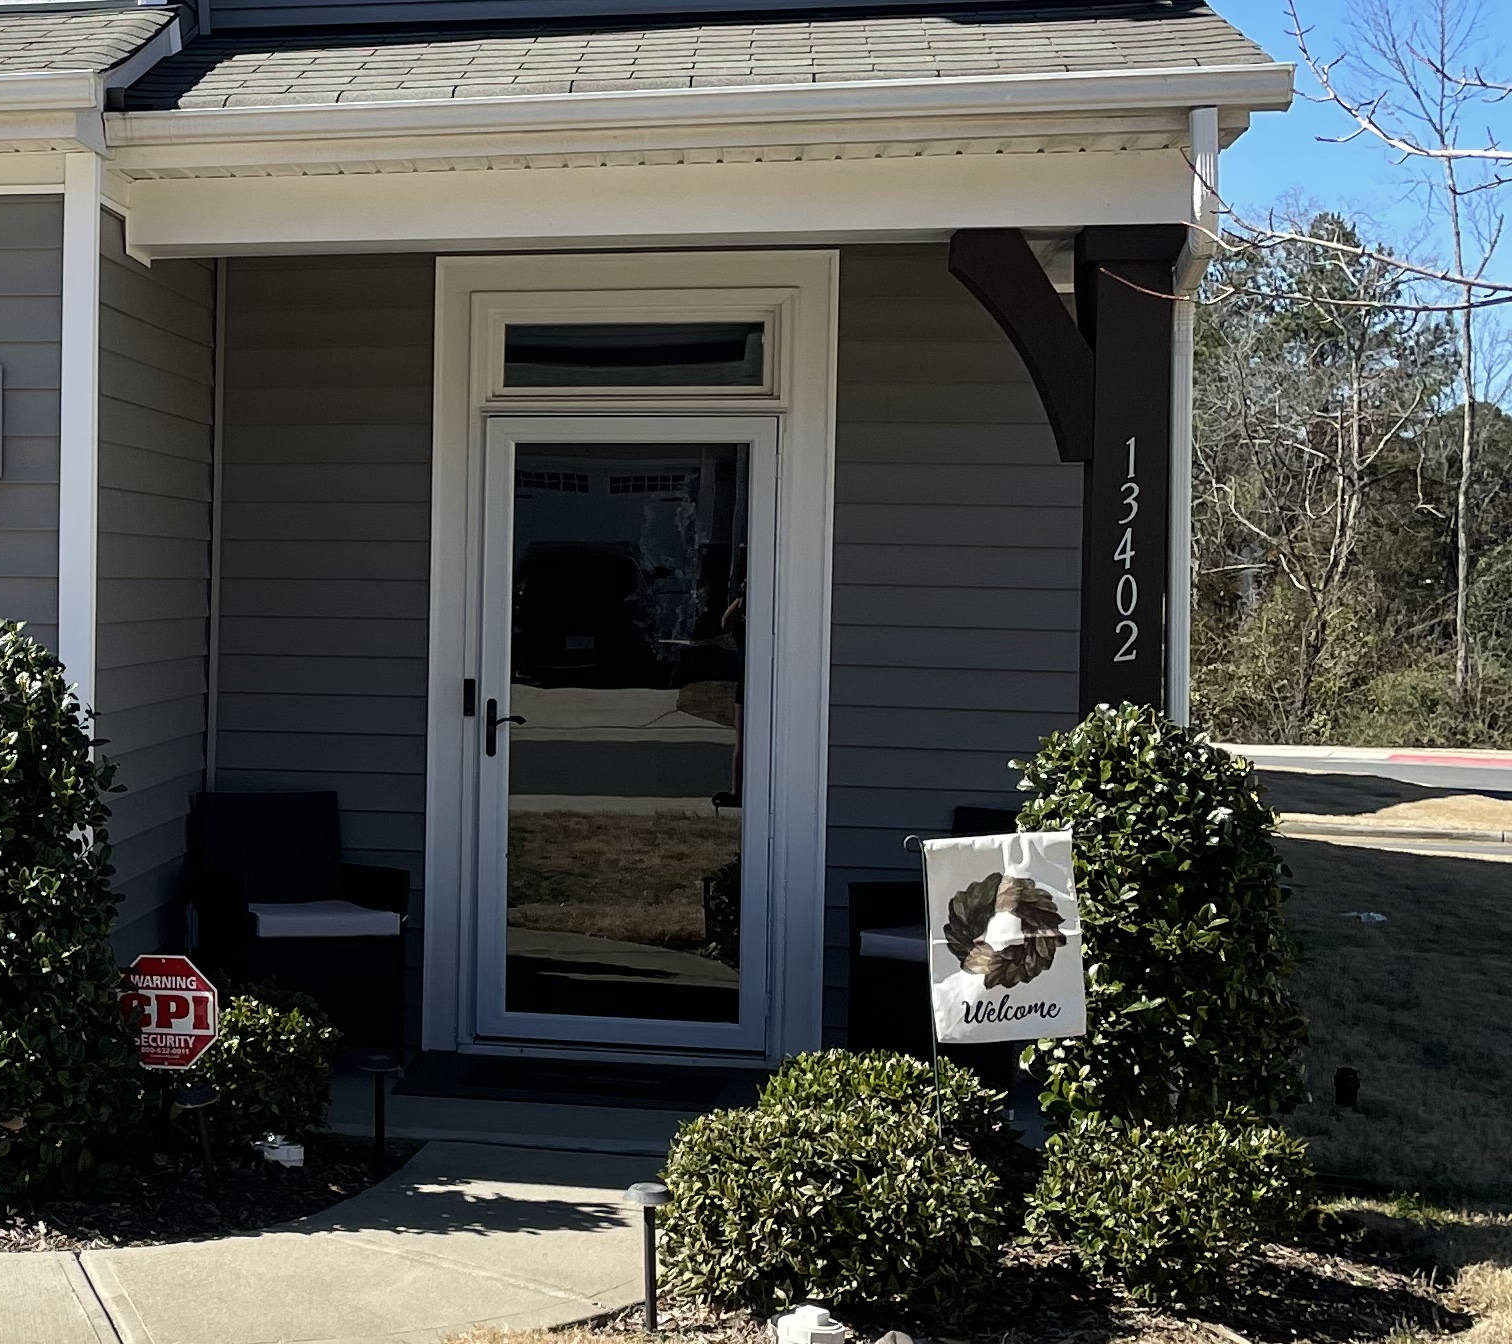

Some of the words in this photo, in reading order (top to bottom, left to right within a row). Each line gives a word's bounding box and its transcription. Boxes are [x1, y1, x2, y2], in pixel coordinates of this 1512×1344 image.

[1113, 436, 1140, 662] 13402
[130, 974, 197, 990] WARNING
[120, 992, 210, 1031] CPI
[961, 994, 1062, 1024] Welcome
